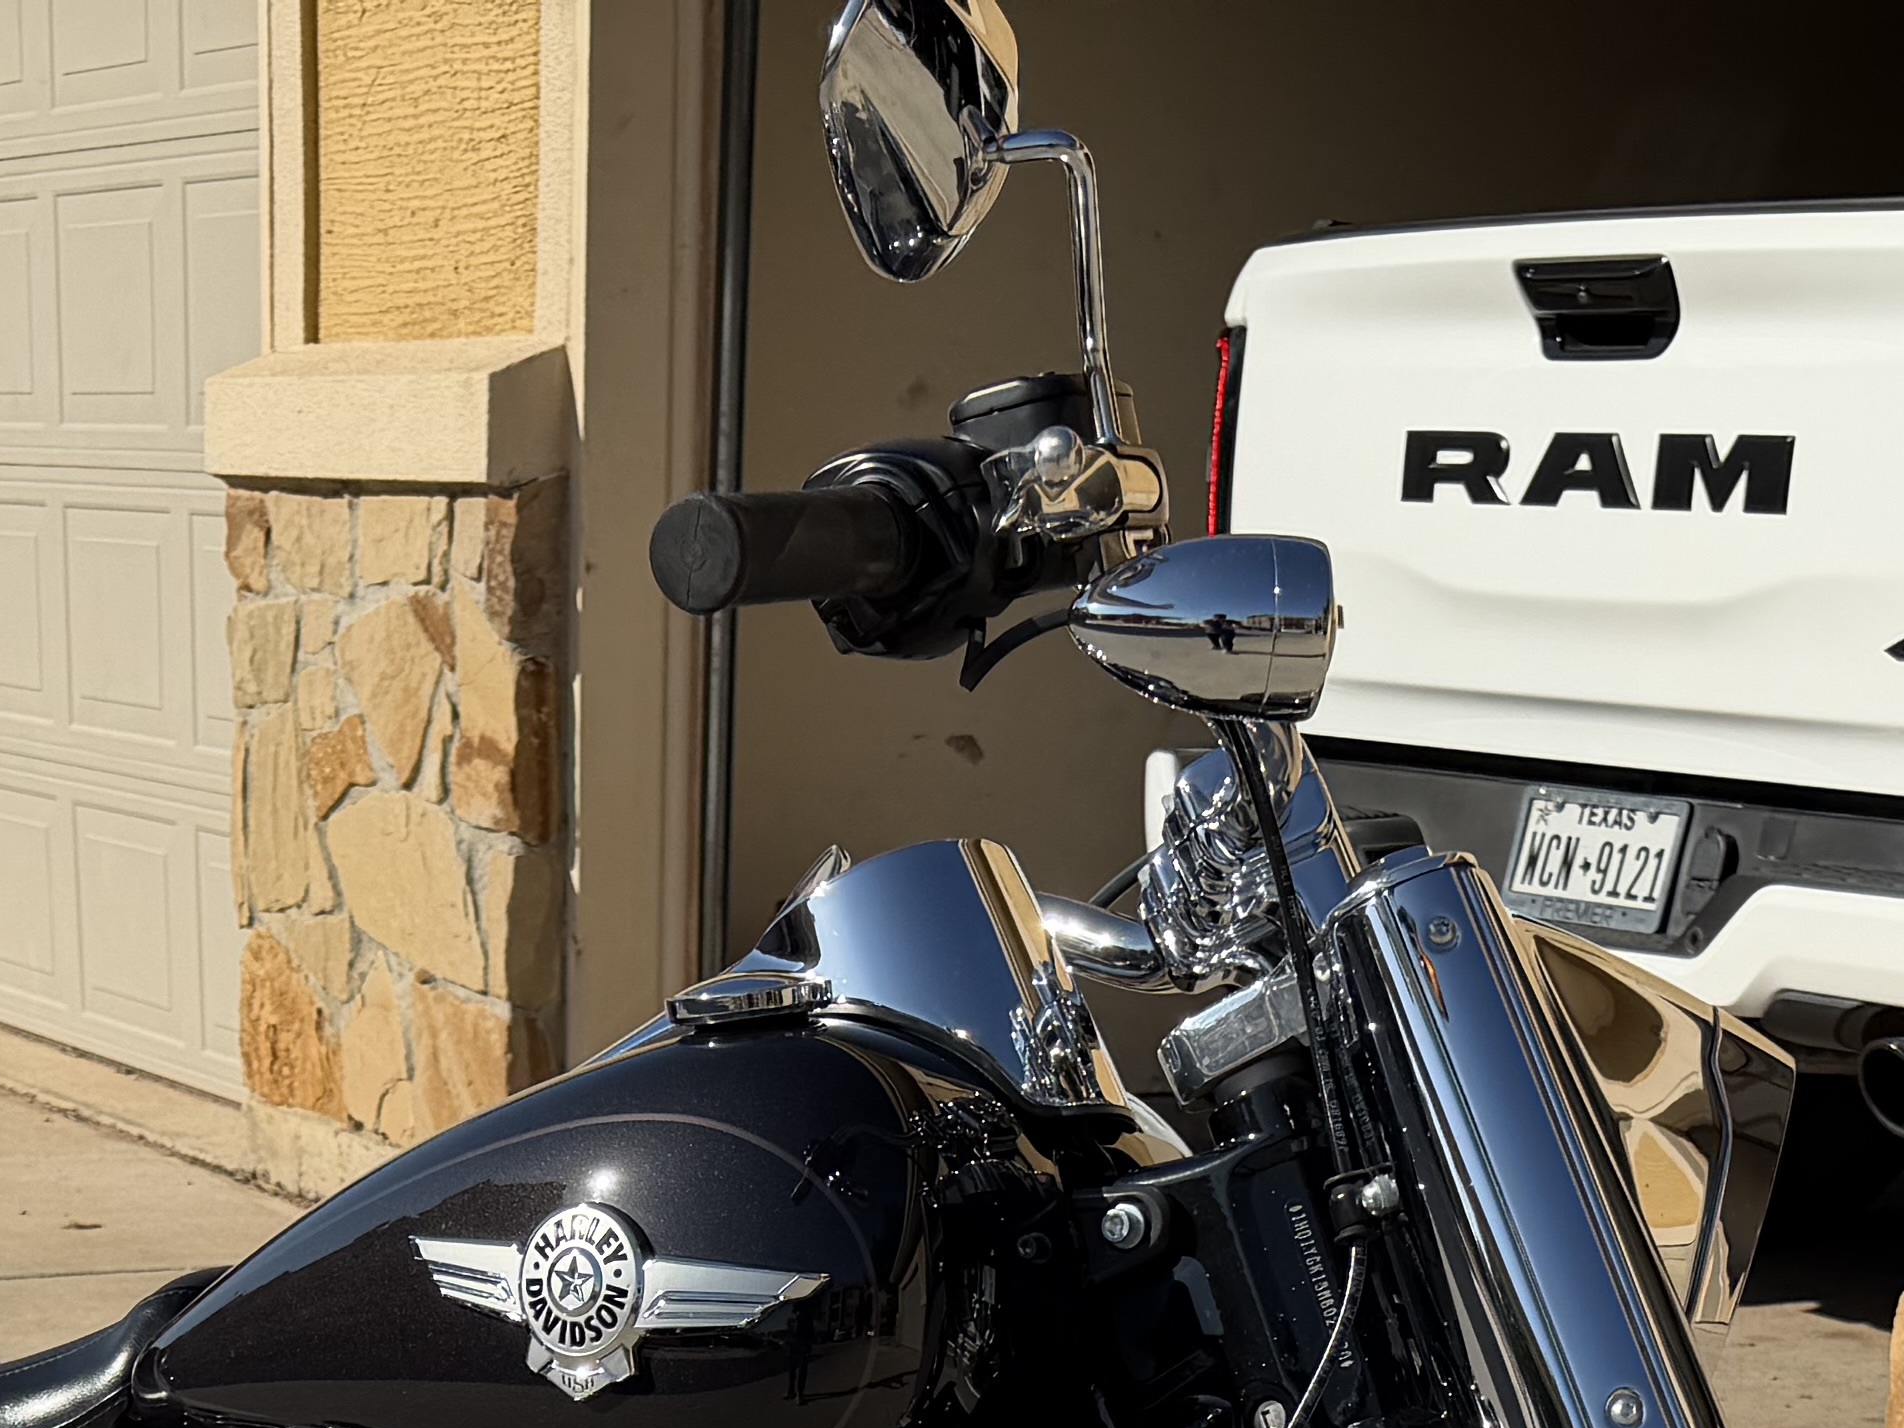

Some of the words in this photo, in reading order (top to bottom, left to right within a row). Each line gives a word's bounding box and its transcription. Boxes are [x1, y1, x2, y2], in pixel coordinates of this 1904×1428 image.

[1400, 429, 1797, 516] RAM
[1577, 803, 1638, 831] TEXAS
[1520, 831, 1580, 891] WCN
[1590, 841, 1665, 903] 9121
[1539, 899, 1614, 926] PREMIER
[534, 1214, 628, 1265] HARLEY
[525, 1277, 629, 1348] DAVIDSON
